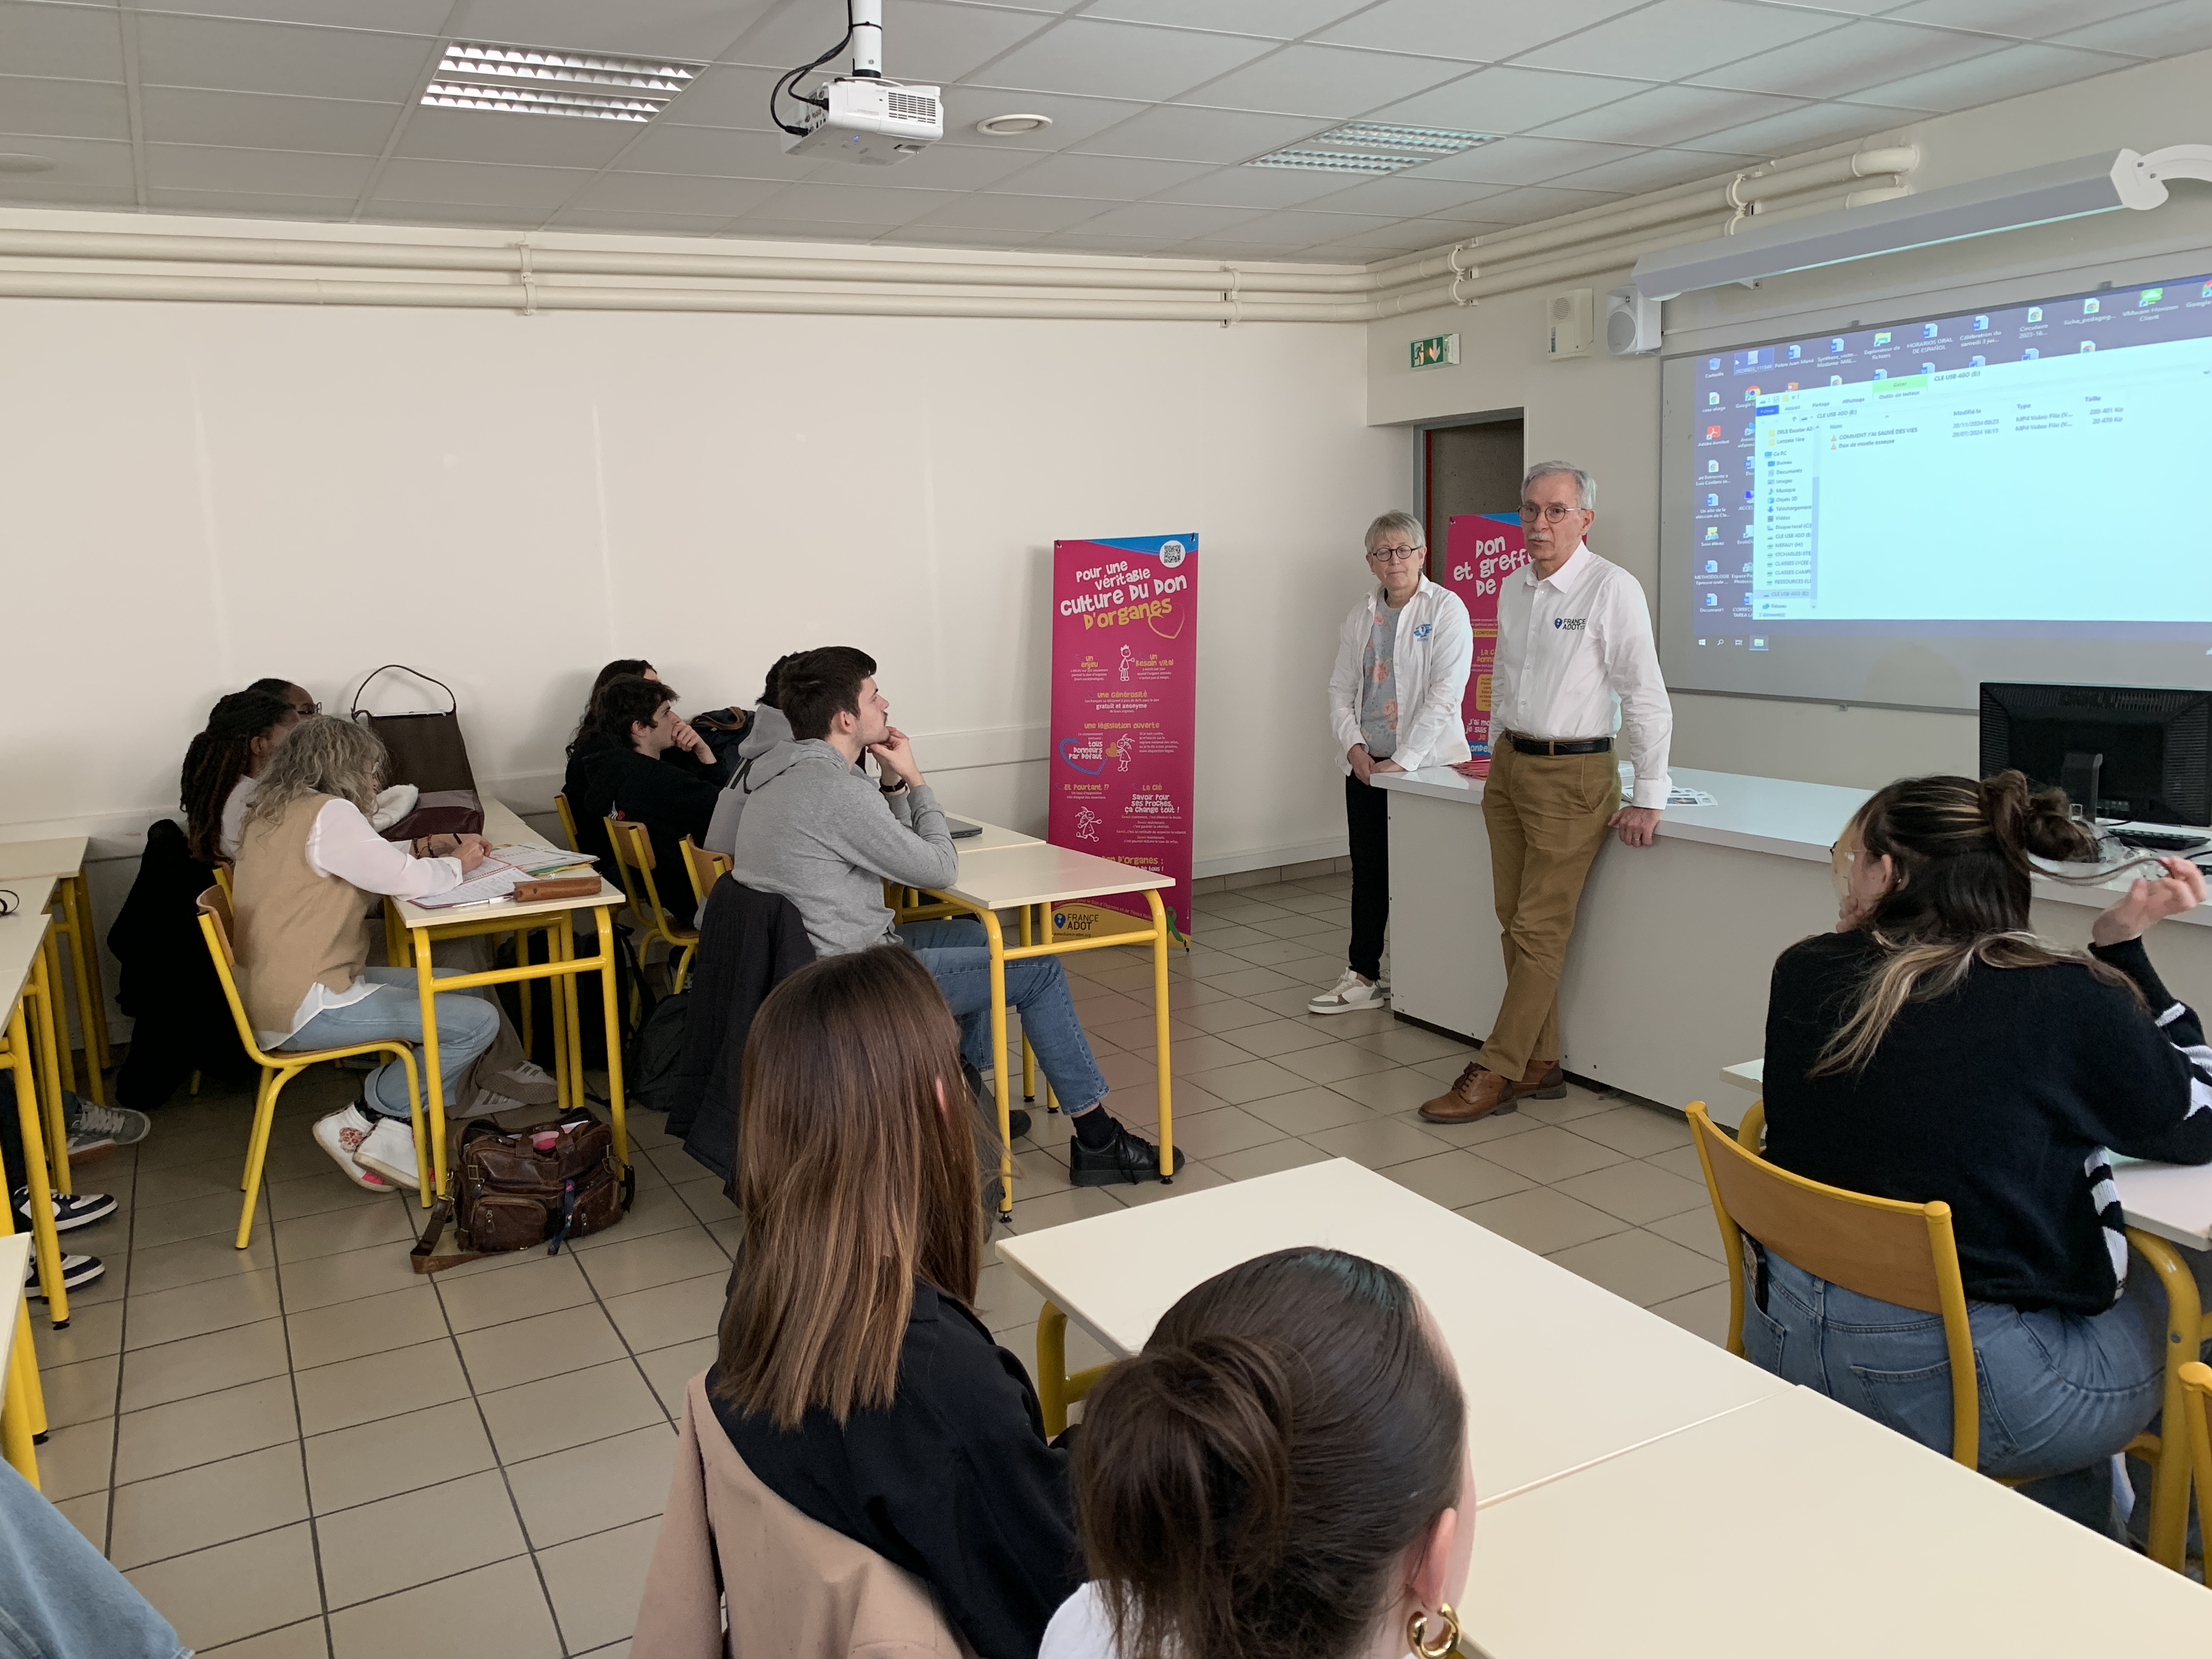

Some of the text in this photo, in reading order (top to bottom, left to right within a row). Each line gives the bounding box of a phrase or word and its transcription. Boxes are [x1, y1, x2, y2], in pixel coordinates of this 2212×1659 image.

[2020, 324, 2049, 332] Circulaire
[1960, 331, 1992, 340] Célébration
[1907, 340, 1937, 349] HORARIOS
[1921, 345, 1946, 353] ESPAÑOL
[1864, 347, 1893, 356] Explorateur
[1954, 408, 1975, 416] Modifié
[1476, 536, 1506, 559] Don
[1076, 561, 1128, 583] Pour une
[1454, 562, 1474, 582] et
[1129, 583, 1149, 601] Du
[1153, 575, 1187, 596] Don
[1476, 578, 1497, 597] De
[1083, 598, 1172, 630] D'organes
[1081, 661, 1098, 670] enjeu
[1465, 725, 1472, 734] je
[1081, 752, 1103, 760] Défaut
[1068, 913, 1099, 922] FRANCE
[1066, 922, 1092, 930] ADOT
